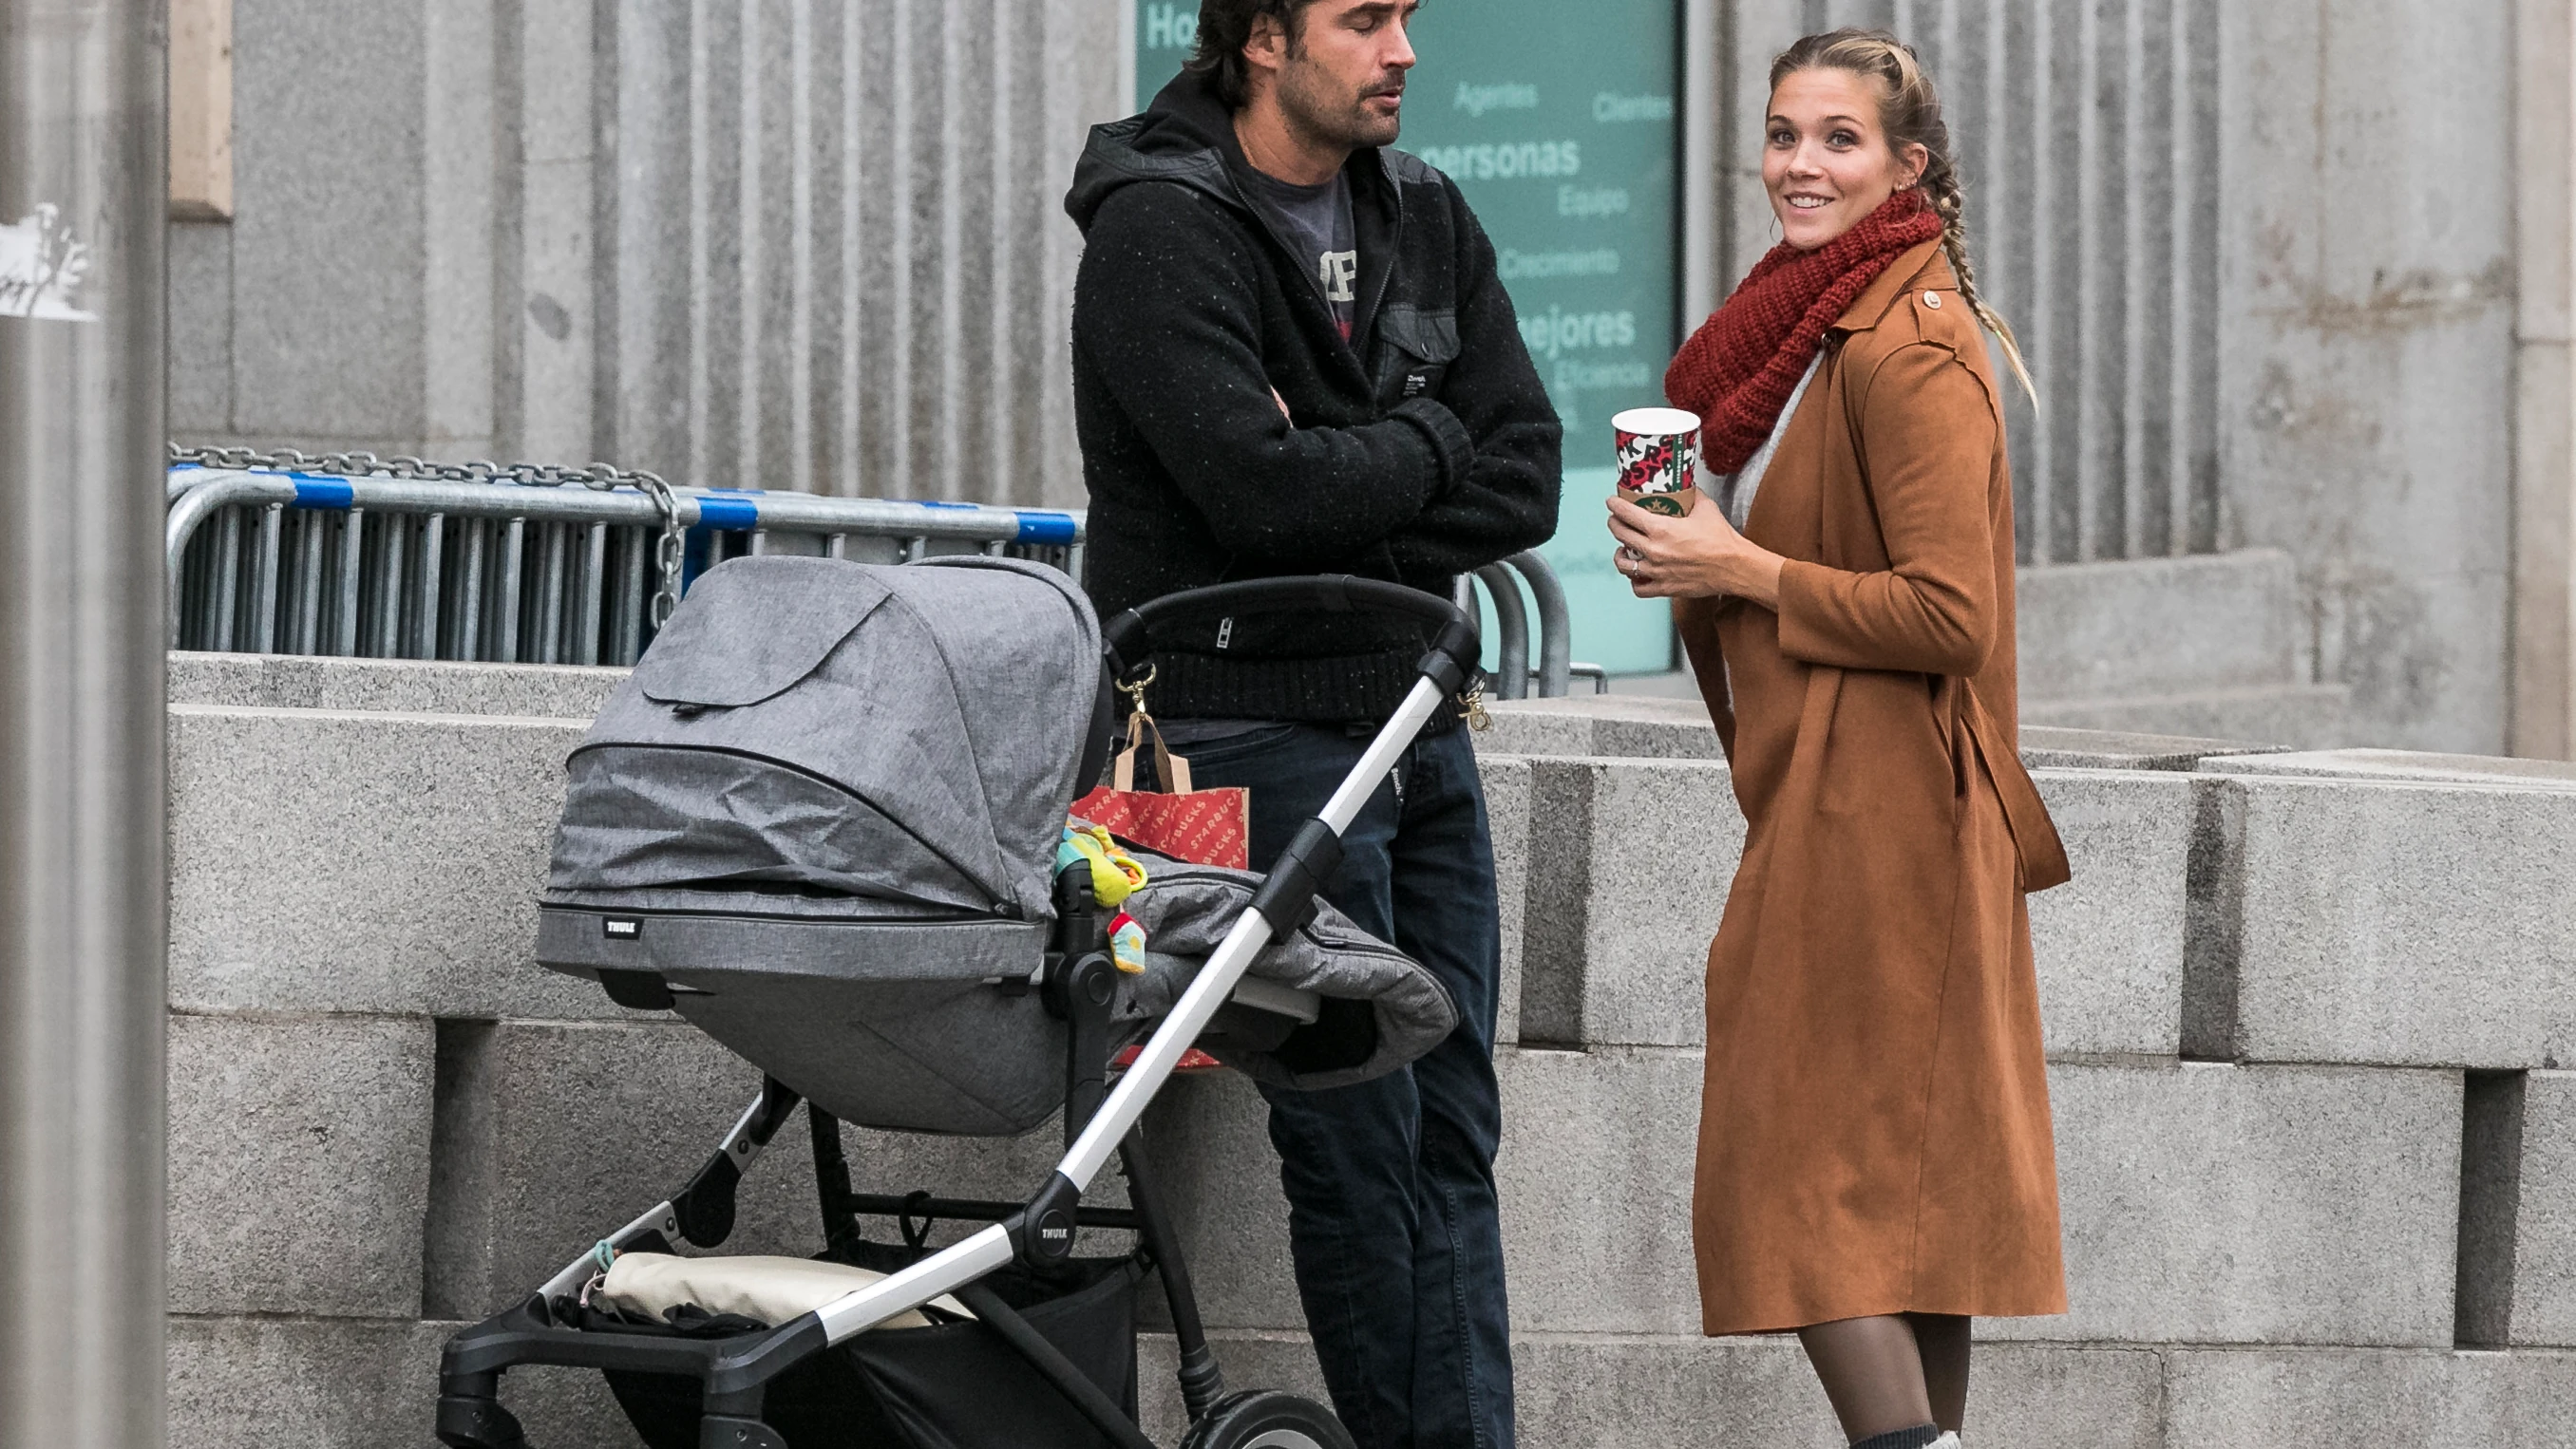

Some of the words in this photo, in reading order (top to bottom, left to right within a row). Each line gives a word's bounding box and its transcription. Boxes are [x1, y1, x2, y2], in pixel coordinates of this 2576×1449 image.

[1558, 185, 1630, 217] Equipo
[607, 921, 635, 932] THULE
[1042, 1228, 1068, 1239] THULE
